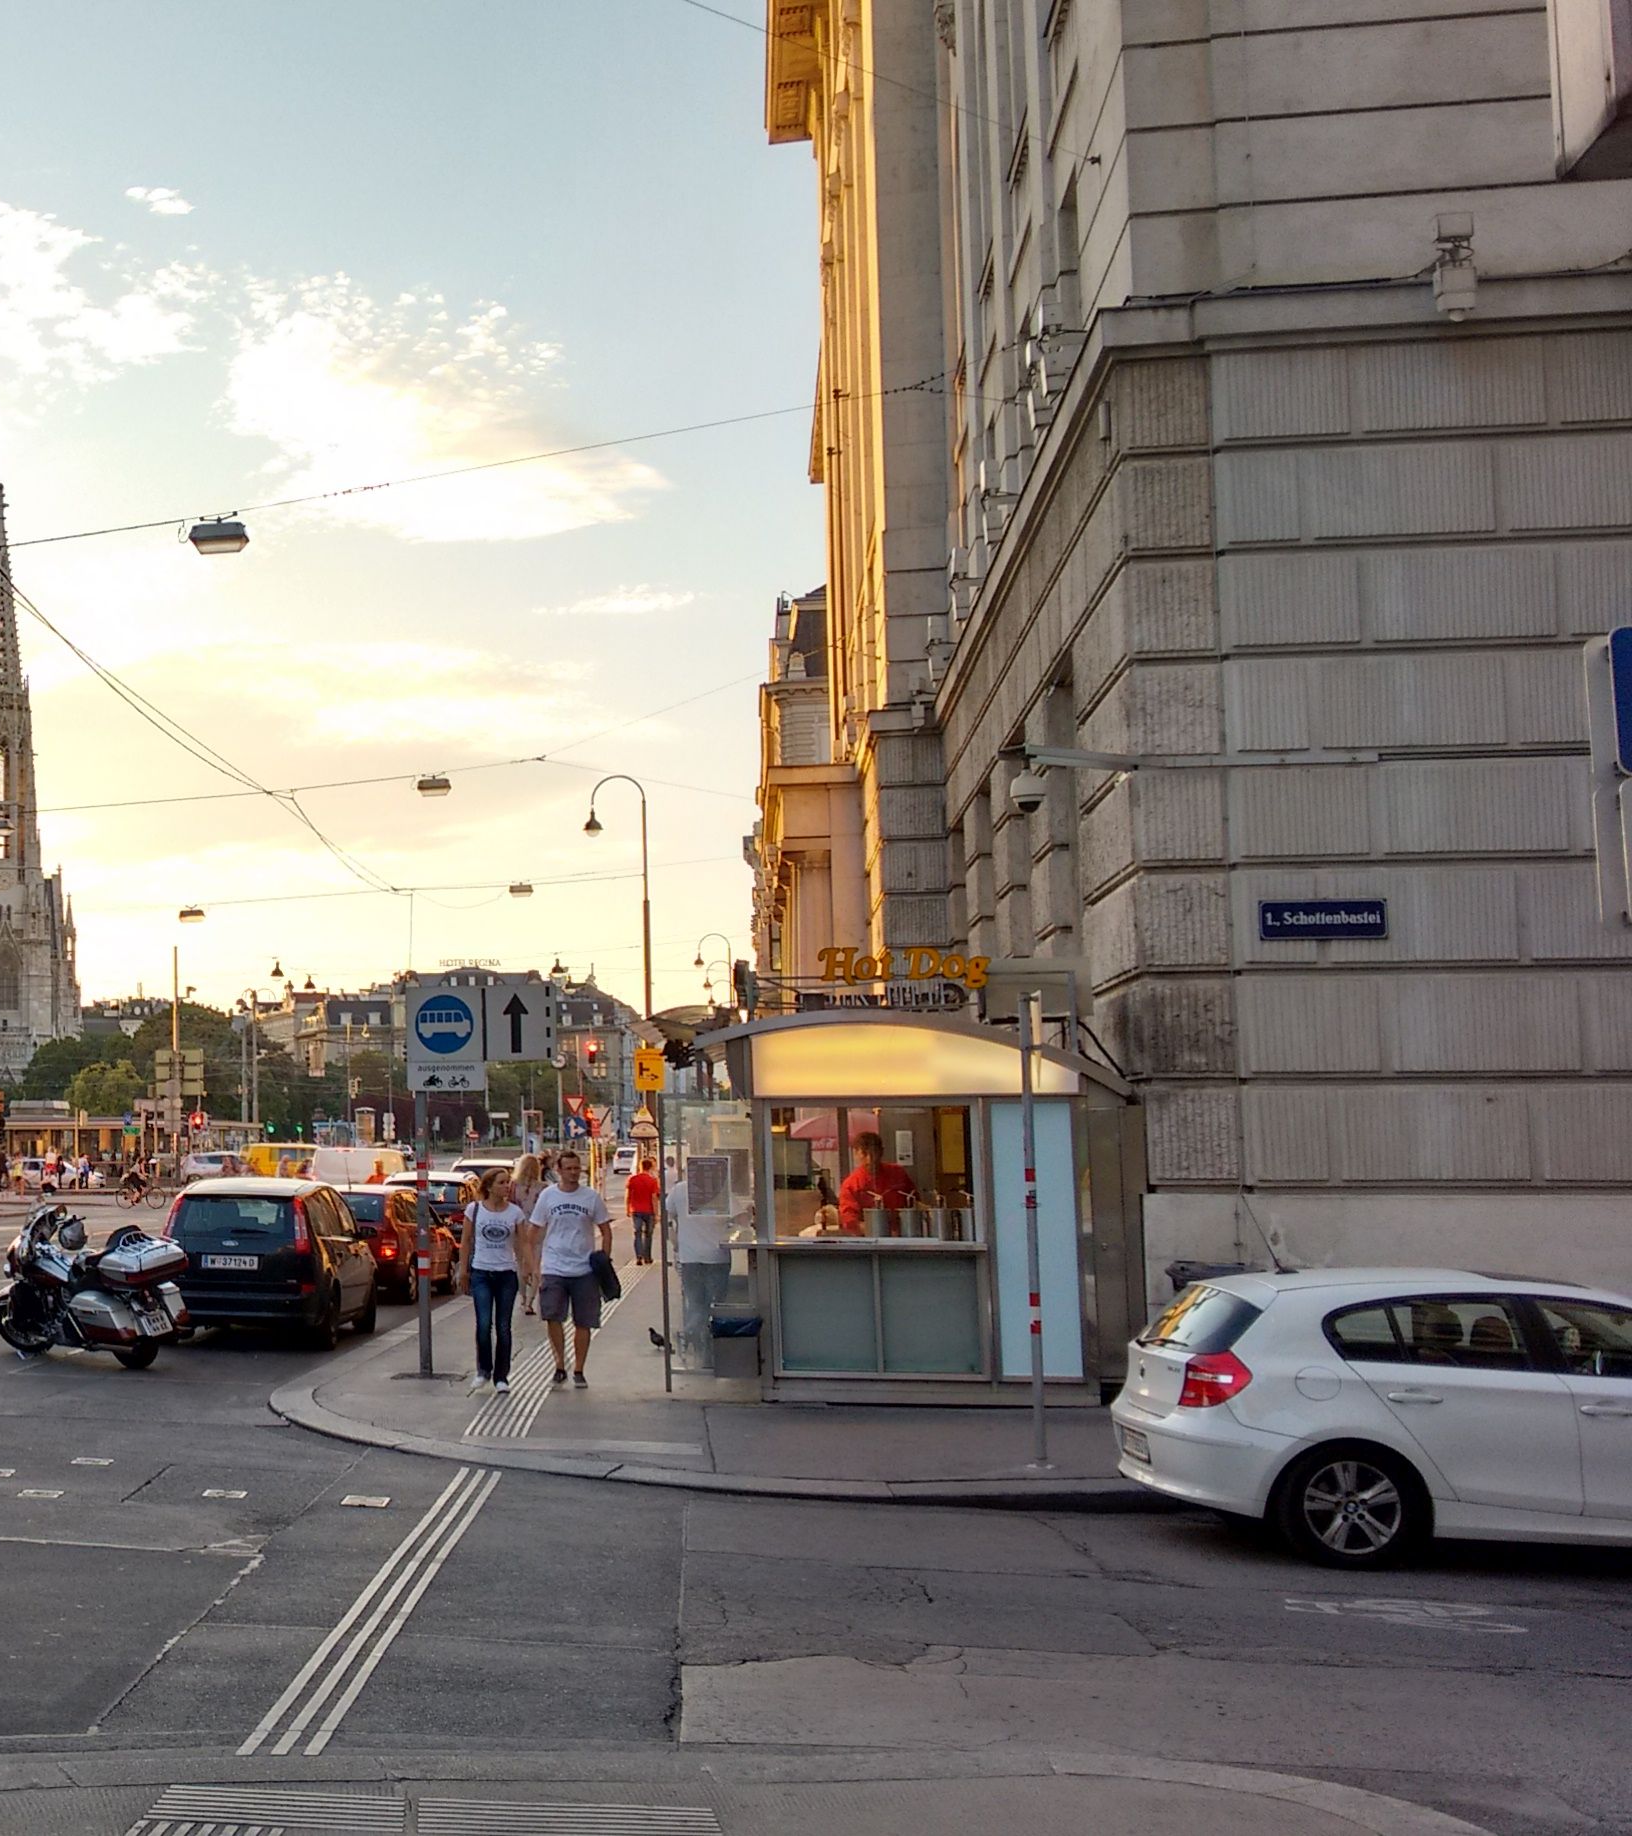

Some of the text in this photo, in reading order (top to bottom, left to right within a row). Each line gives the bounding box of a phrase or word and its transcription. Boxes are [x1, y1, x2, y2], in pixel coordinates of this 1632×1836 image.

[1283, 910, 1381, 926] Schottenbastei
[439, 959, 501, 967] HOTEL REGINA
[817, 946, 992, 989] Hot Dog
[417, 1063, 475, 1073] ausgenommen
